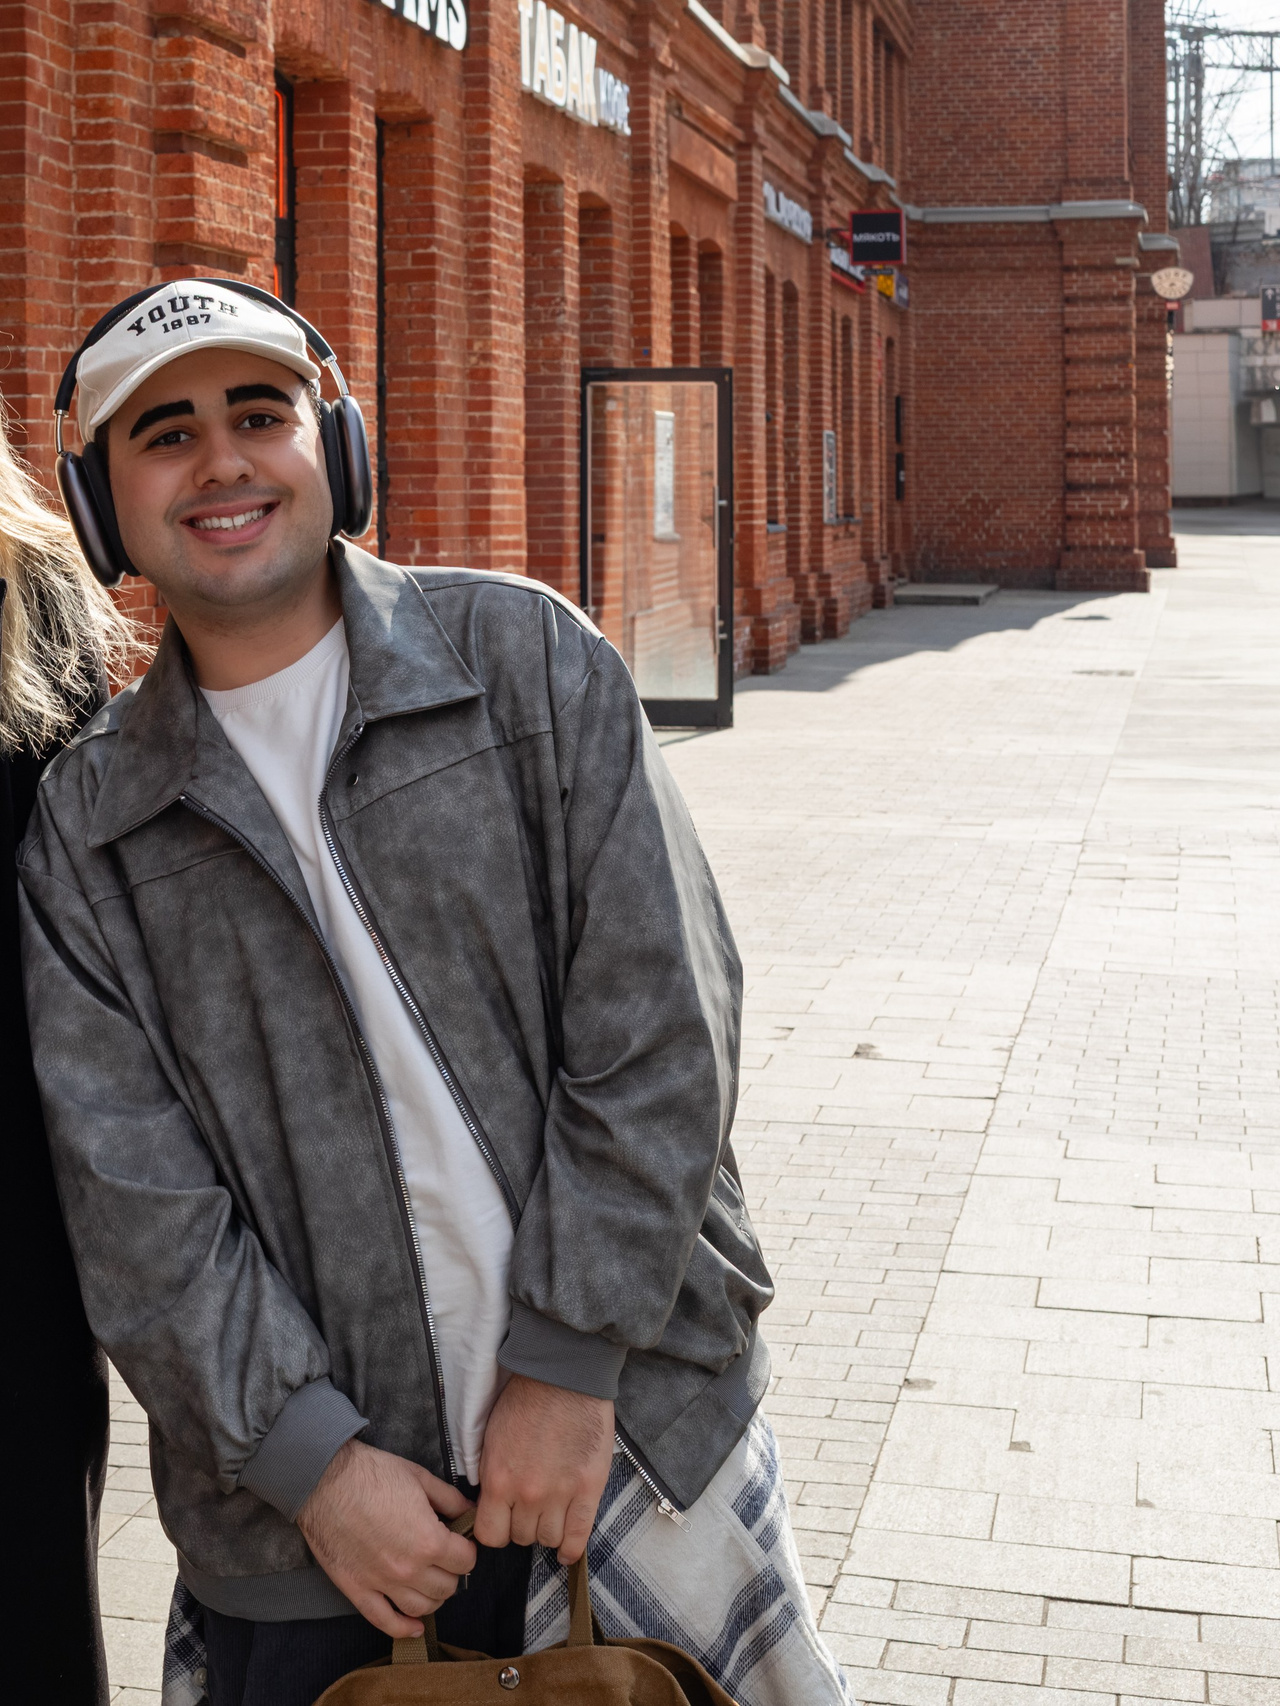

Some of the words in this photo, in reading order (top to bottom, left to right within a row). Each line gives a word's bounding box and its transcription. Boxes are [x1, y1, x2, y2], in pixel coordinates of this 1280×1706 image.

[518, 0, 599, 127] ТАБАК
[852, 231, 900, 242] МЯКОТЬ
[127, 295, 239, 336] YOUTH
[162, 314, 211, 334] 1887
